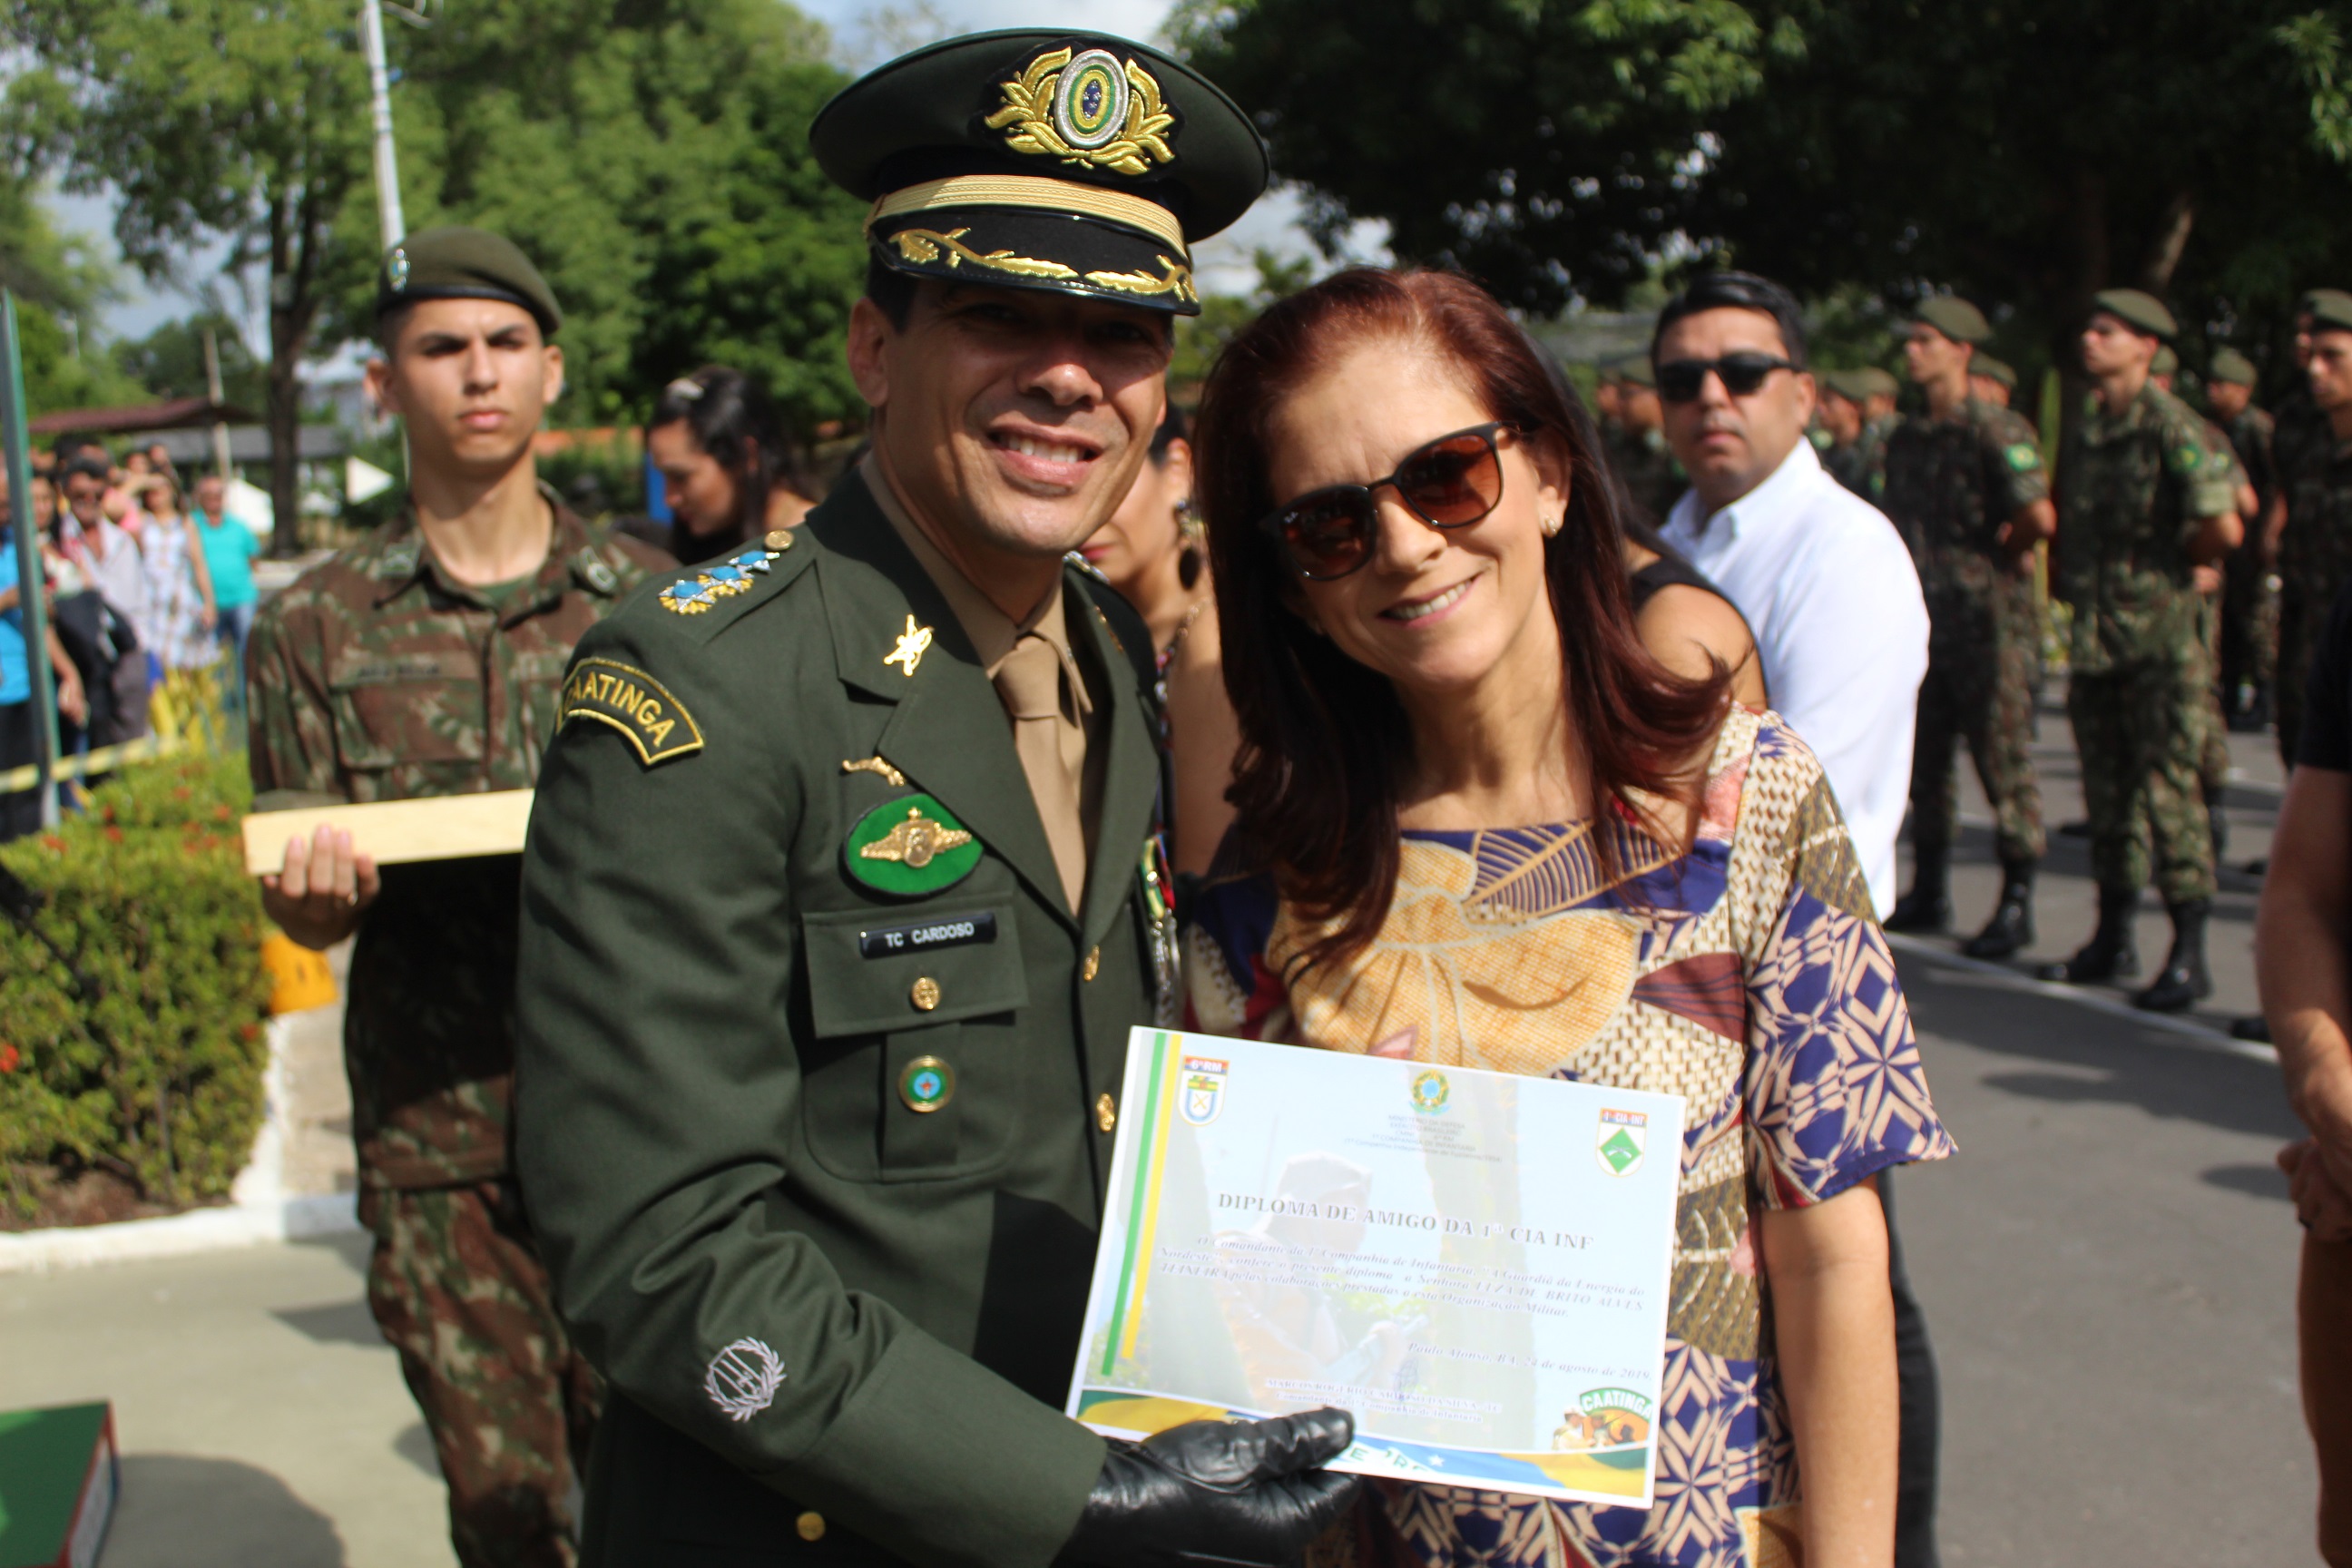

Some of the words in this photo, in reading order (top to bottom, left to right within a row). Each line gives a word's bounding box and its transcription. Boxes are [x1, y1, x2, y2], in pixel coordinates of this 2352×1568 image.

[884, 932, 904, 947] TC
[911, 921, 975, 944] CARDOSO
[1219, 1193, 1318, 1219] DIPLOMA
[1327, 1205, 1356, 1221] DE
[1363, 1210, 1438, 1231] AMIGO
[1445, 1219, 1474, 1236] DA
[1510, 1227, 1546, 1245] CIA
[1554, 1231, 1594, 1251] INF
[1198, 1235, 1208, 1245] O
[1212, 1237, 1288, 1254] Comandante
[1289, 1245, 1304, 1256] da
[1322, 1248, 1390, 1264] Companhia
[1393, 1257, 1406, 1267] de
[1556, 1275, 1572, 1289] da
[1575, 1279, 1626, 1297] Energia
[1628, 1283, 1645, 1297] do
[1230, 1256, 1275, 1269] confere
[1291, 1261, 1341, 1275] presente
[1346, 1266, 1393, 1282] diploma
[1417, 1274, 1470, 1290] Senhora
[1519, 1286, 1537, 1298] DE
[1545, 1289, 1591, 1304] BRITO
[1264, 1272, 1340, 1289] colaborações
[1343, 1281, 1398, 1297] prestadas
[1407, 1342, 1444, 1357] Paulo
[1542, 1359, 1555, 1369] de
[1559, 1363, 1599, 1377] agosto
[1602, 1364, 1617, 1376] de
[1582, 1389, 1652, 1421] CAATINGA
